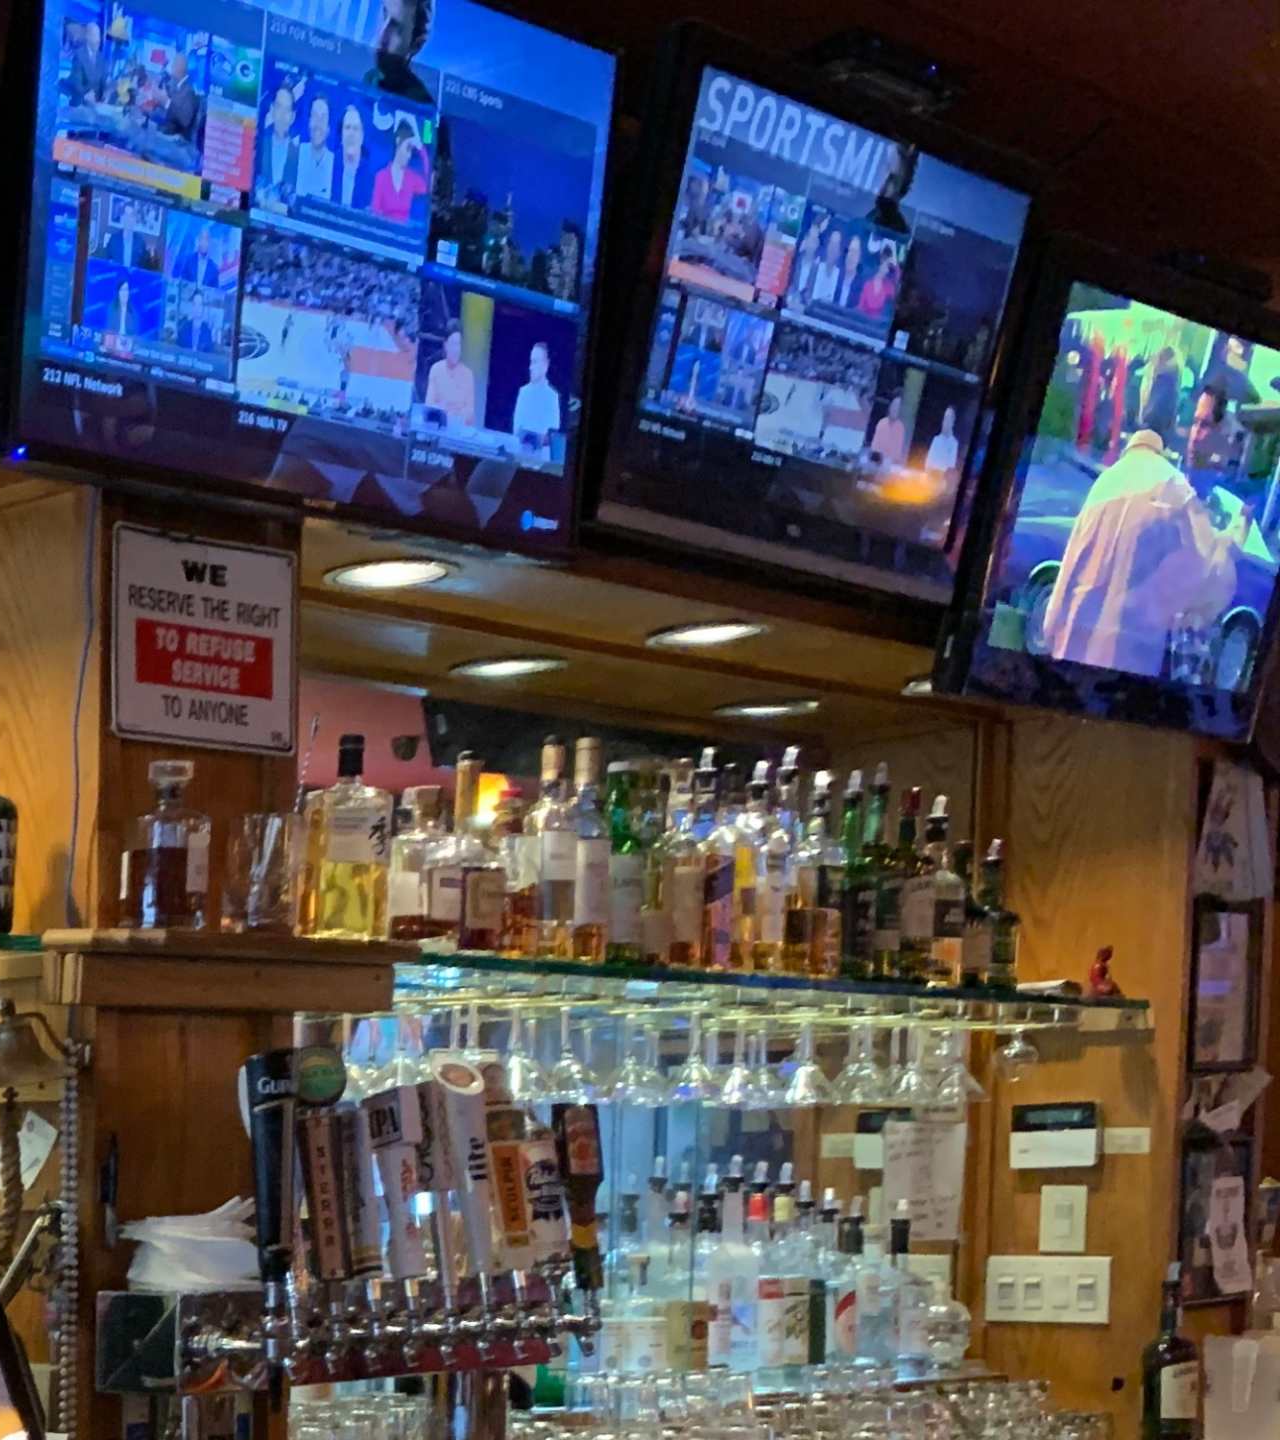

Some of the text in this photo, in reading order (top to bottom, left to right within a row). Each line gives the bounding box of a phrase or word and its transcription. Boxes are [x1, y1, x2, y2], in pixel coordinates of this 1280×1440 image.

[83, 376, 124, 398] Network
[181, 560, 227, 588] WE
[128, 584, 281, 629] RESERVE THE RIGHT
[155, 627, 256, 663] TO REFUSE
[172, 659, 240, 689] SERVICE
[161, 695, 249, 727] TO ANYONE
